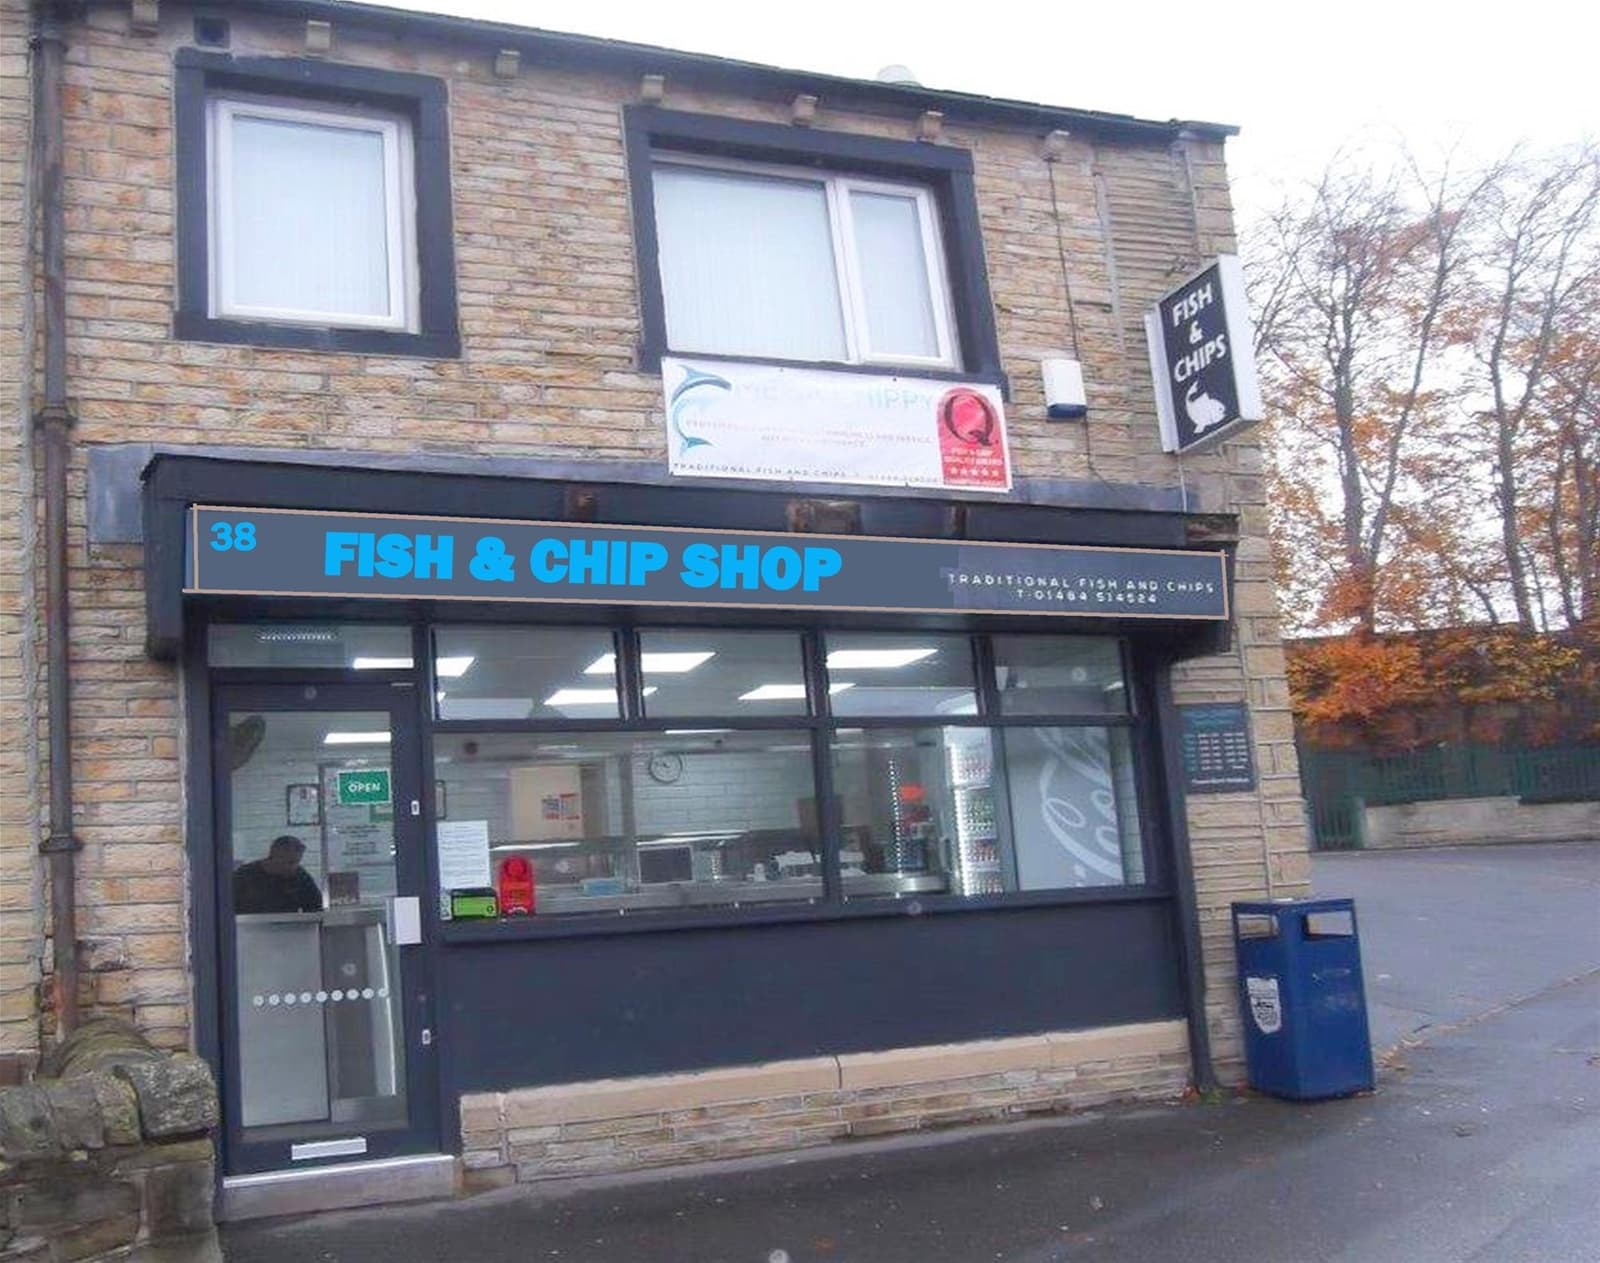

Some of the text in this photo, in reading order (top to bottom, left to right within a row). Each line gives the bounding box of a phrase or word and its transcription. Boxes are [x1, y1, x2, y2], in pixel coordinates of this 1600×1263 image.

[1172, 283, 1213, 327] FISH
[1188, 321, 1204, 343] &
[1173, 334, 1227, 383] CHIPS
[211, 521, 257, 552] 38
[324, 531, 843, 592] FISH & CHIP SHOP
[947, 572, 1214, 593] TRADITIONAL FISH AND CHIPS
[347, 782, 381, 793] OPEN
